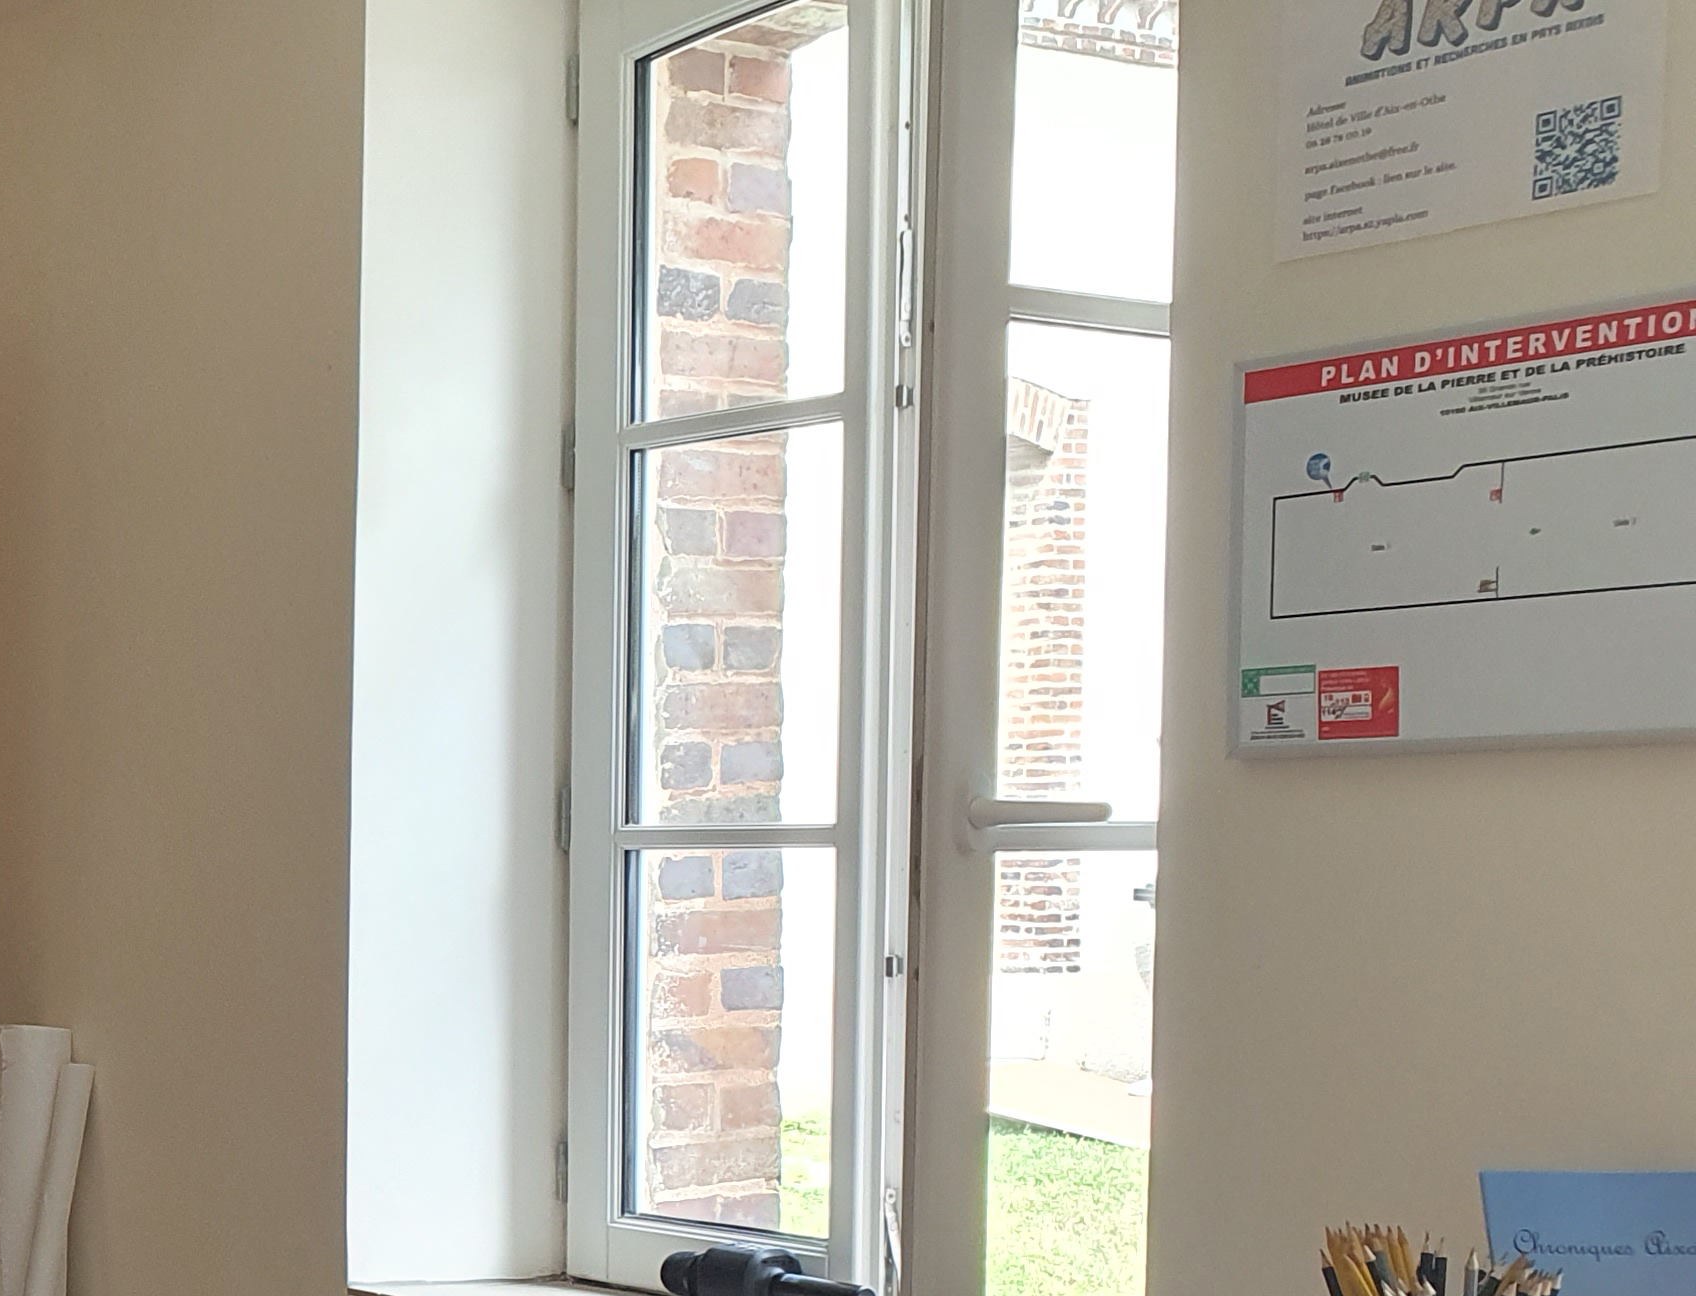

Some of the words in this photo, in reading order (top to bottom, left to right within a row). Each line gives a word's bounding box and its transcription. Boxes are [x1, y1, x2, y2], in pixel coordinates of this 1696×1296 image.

[1345, 62, 1412, 87] ANIMATIONS
[1416, 57, 1430, 70] ET
[1434, 37, 1507, 66] RECHERCHES
[1511, 33, 1527, 47] EN
[1531, 23, 1561, 42] PAYS
[1306, 117, 1333, 133] Hôtel
[1335, 116, 1348, 127] de
[1350, 110, 1372, 123] Ville
[1307, 102, 1346, 117] Adresse
[1304, 189, 1328, 202] page
[1329, 176, 1376, 195] facebook
[1383, 173, 1403, 184] lien
[1405, 169, 1422, 180] sur
[1423, 165, 1433, 175] le
[1303, 215, 1321, 226] site
[1323, 206, 1363, 222] internet
[1321, 355, 1399, 387] PLAN
[1339, 388, 1390, 404] MUSEE
[1394, 384, 1414, 397] DE
[1418, 381, 1436, 393] LA
[1441, 371, 1497, 389] PIERRE
[1500, 368, 1520, 381] ET
[1525, 364, 1546, 378] DE
[1550, 361, 1571, 373] LA
[1575, 343, 1686, 370] PRÉHISTOIRE
[1513, 1228, 1634, 1262] Chroniques
